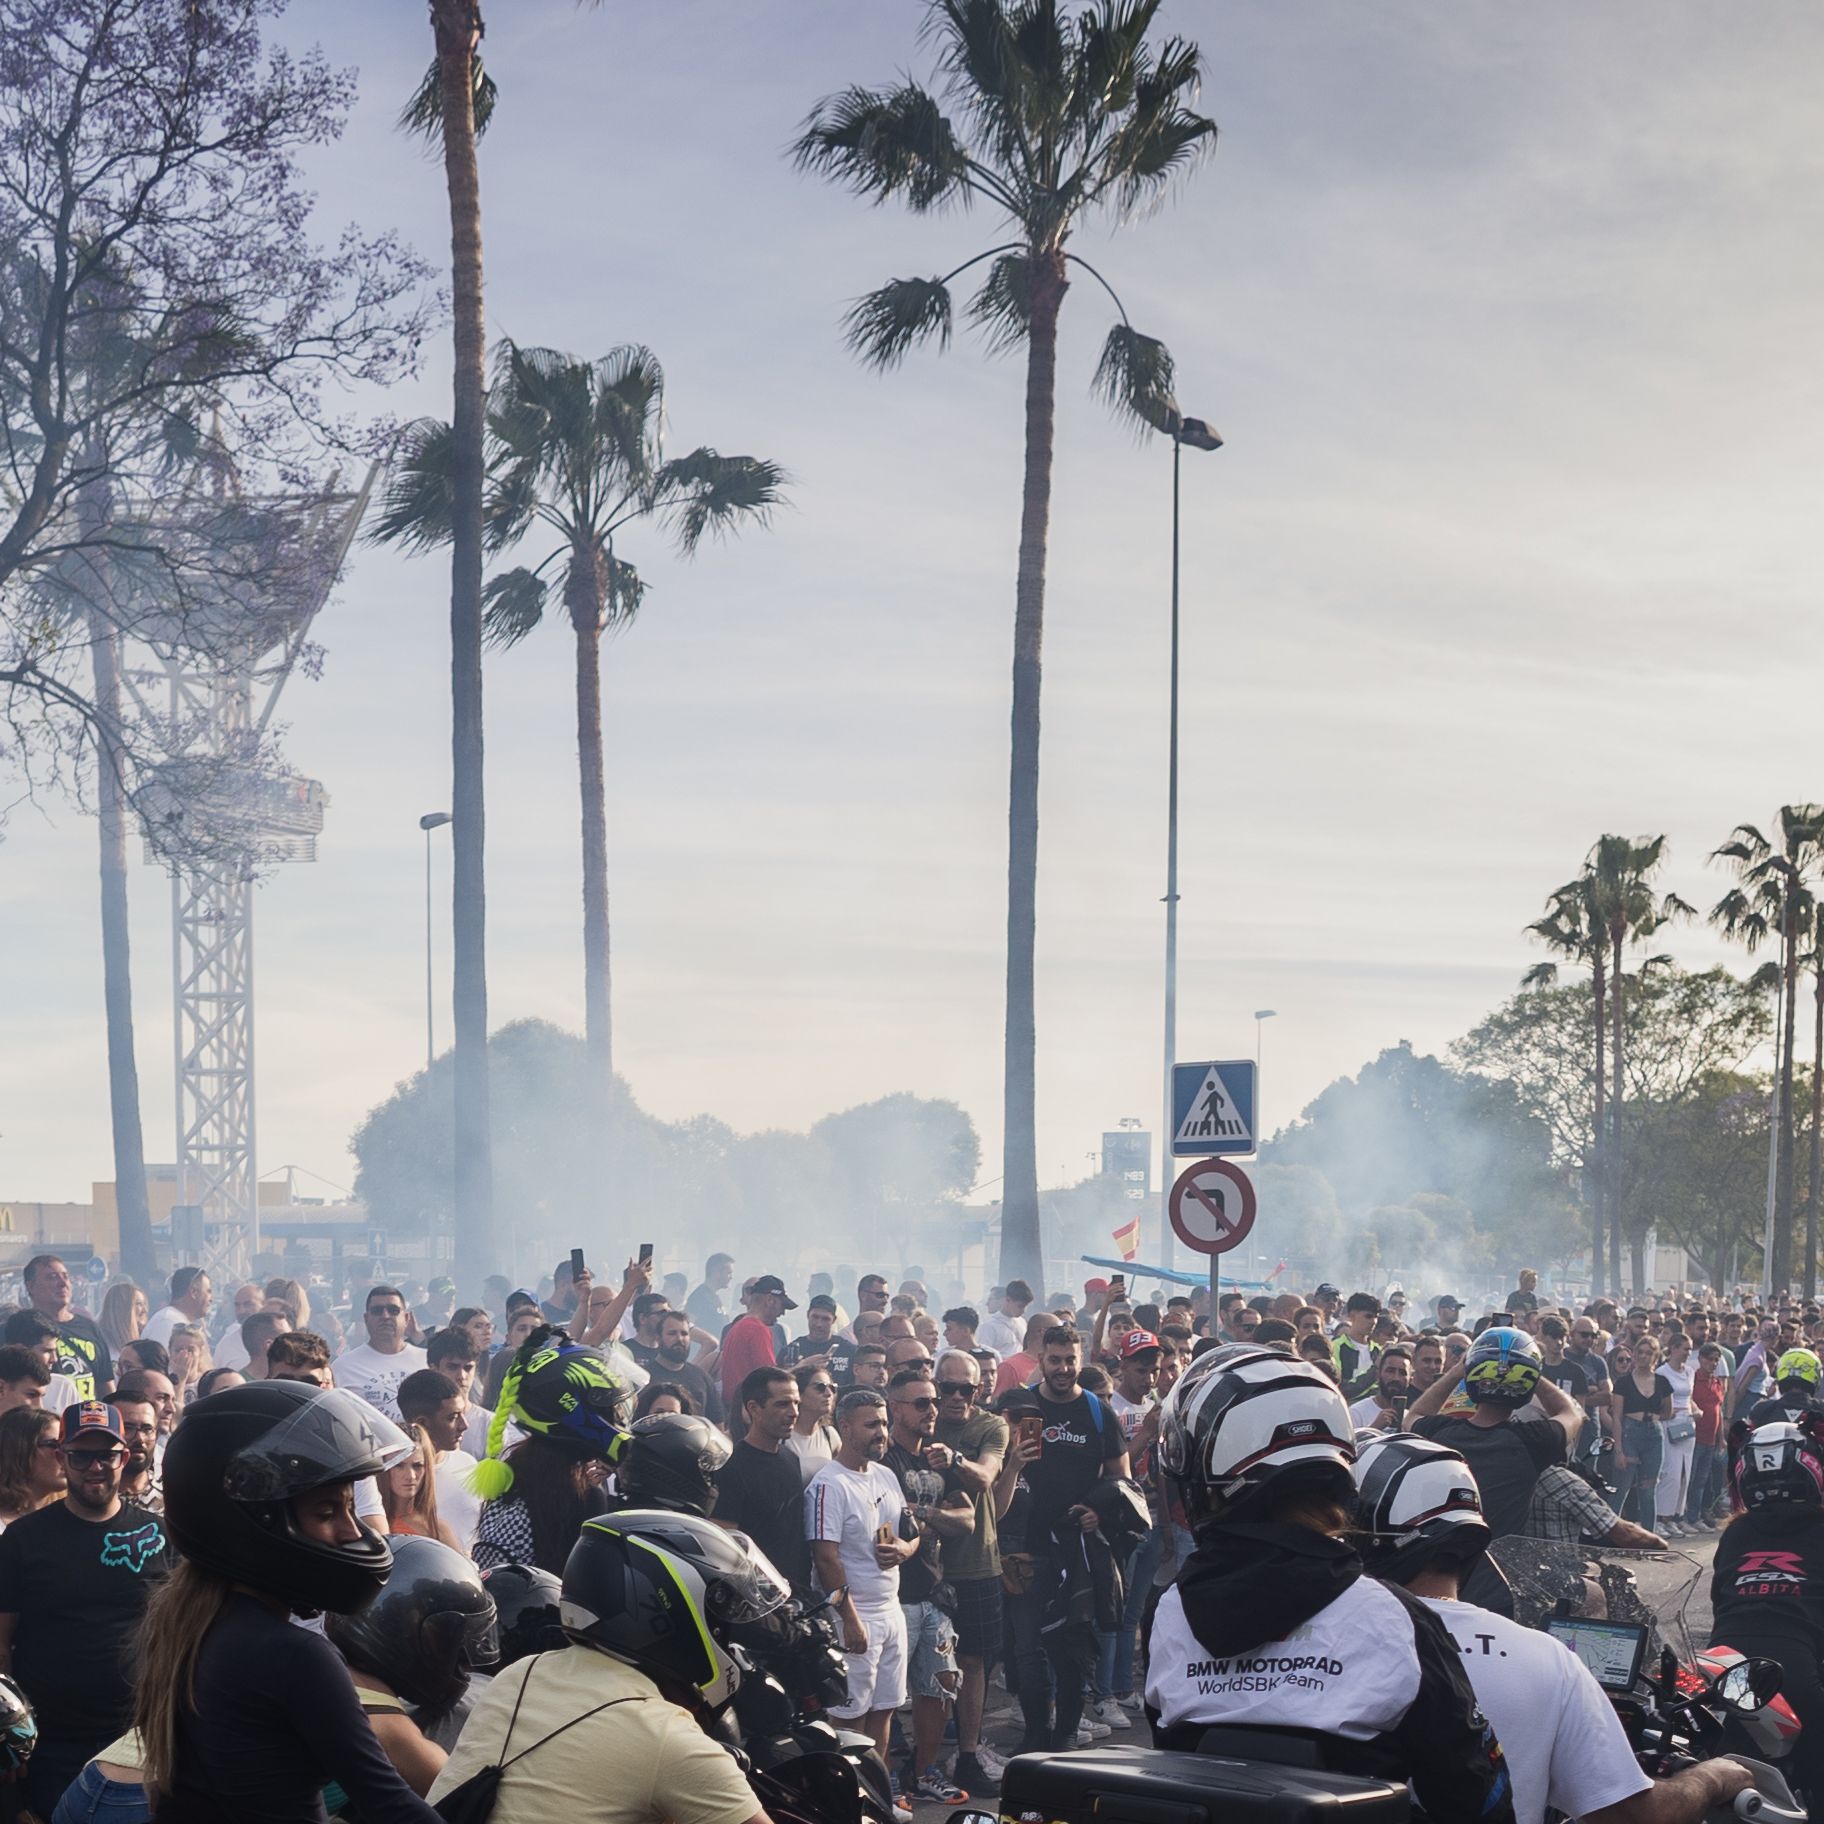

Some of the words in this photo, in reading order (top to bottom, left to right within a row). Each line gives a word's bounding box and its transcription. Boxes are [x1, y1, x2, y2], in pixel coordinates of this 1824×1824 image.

[1737, 1583, 1803, 1598] ALBITA
[1186, 1660, 1228, 1679] BMW
[1235, 1655, 1344, 1676] MOTORRAD
[1197, 1675, 1278, 1696] WorldSBK
